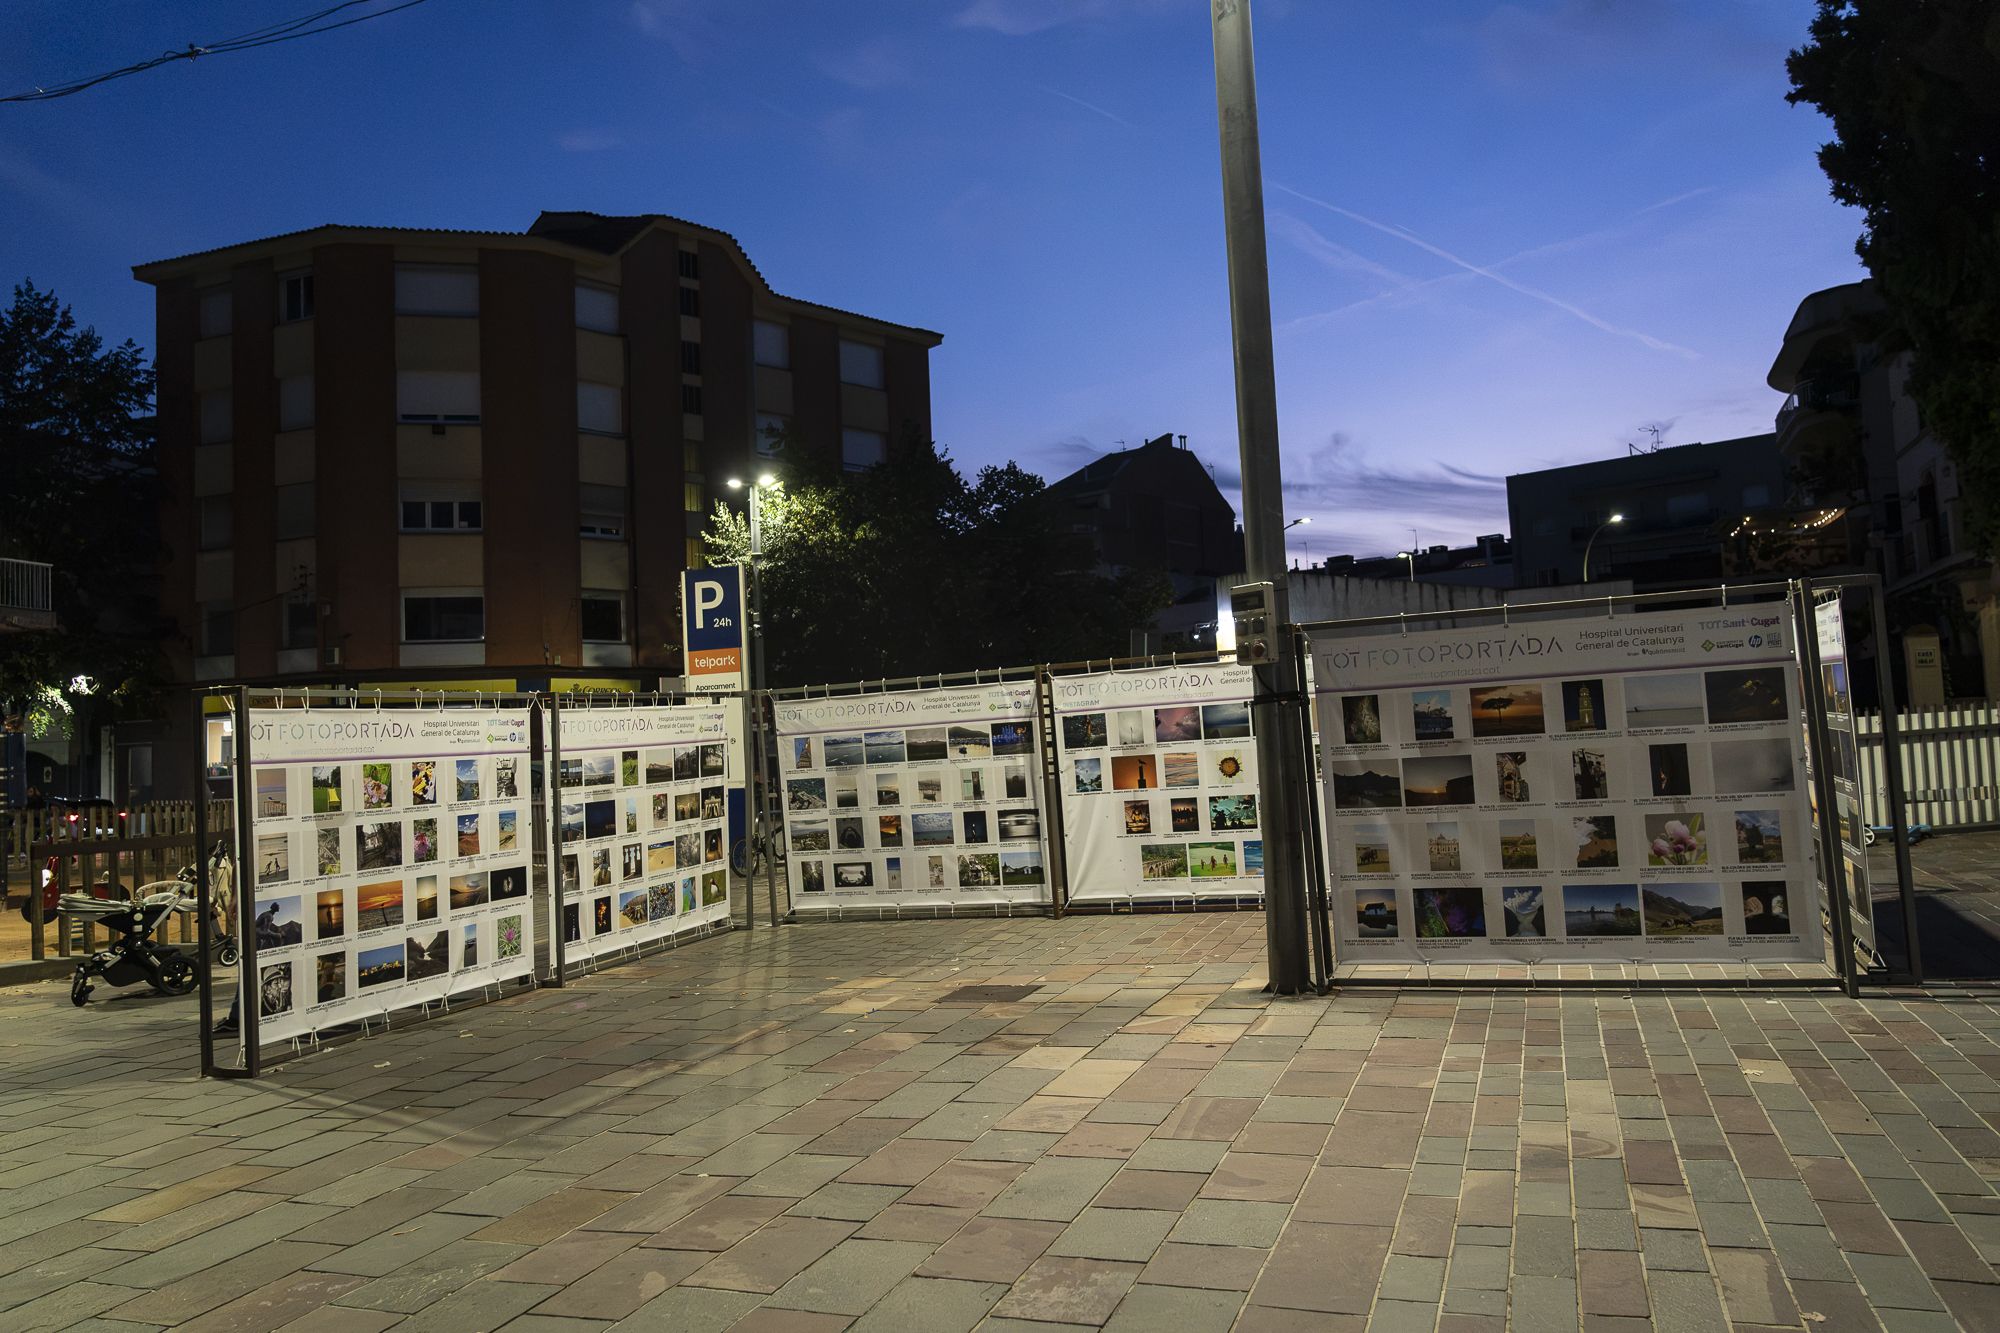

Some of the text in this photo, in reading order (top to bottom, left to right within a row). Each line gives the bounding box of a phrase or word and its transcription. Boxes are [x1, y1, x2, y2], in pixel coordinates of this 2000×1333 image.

[694, 580, 724, 629] P
[713, 617, 732, 628] 24h
[1579, 624, 1684, 640] Hospital Universitari
[1575, 635, 1685, 651] General de Catalunya
[1322, 637, 1563, 669] TOT FOTOPORTADA
[694, 655, 736, 669] telpark
[1223, 669, 1250, 677] Hospital
[695, 682, 736, 692] Aparcament
[1088, 674, 1213, 694] FOTOPORTADA
[1220, 677, 1247, 685] General
[923, 695, 947, 703] Hospital
[806, 701, 916, 720] FOTOPORTADA
[279, 722, 415, 740] FOTOPORTADA
[423, 719, 480, 728] Hospital Universitari
[570, 718, 653, 734] FOTOPORTADA
[420, 729, 480, 738] General de Catalunya
